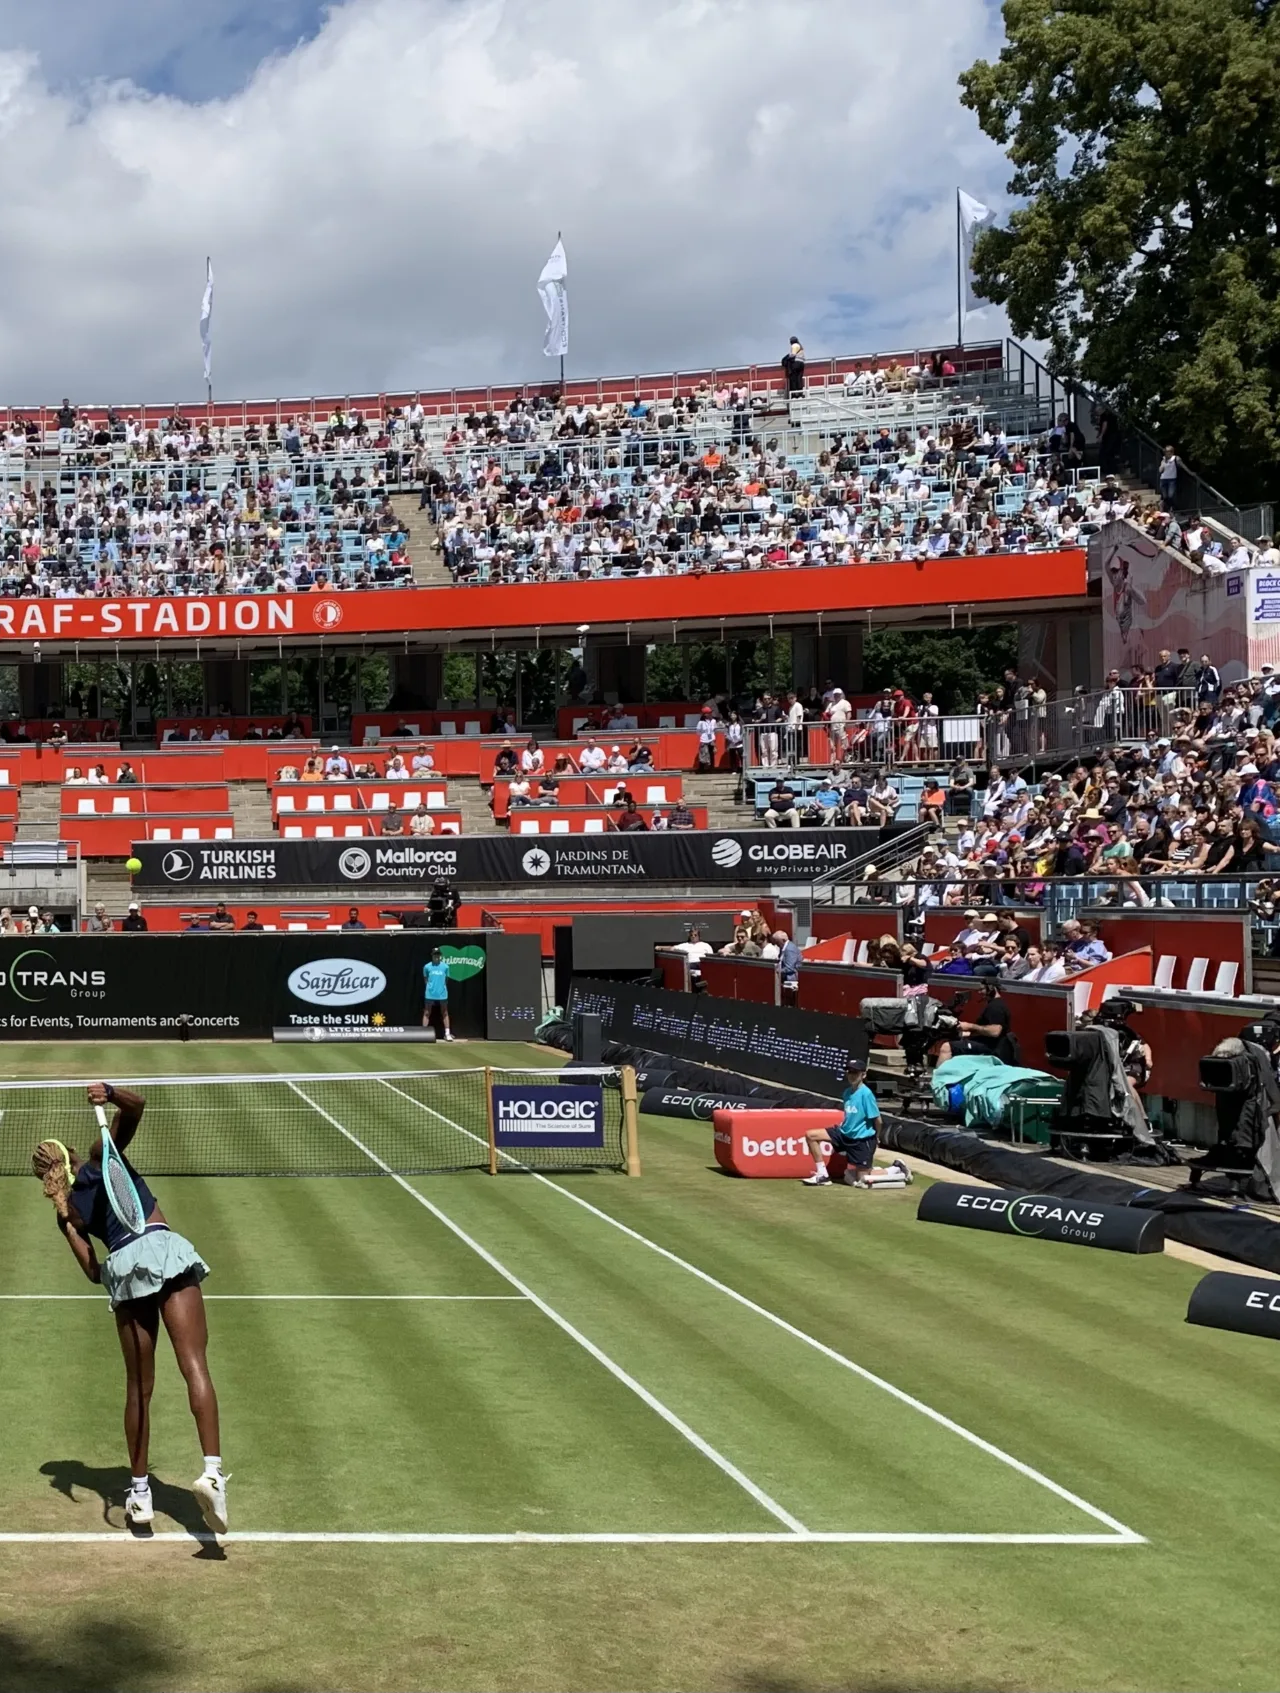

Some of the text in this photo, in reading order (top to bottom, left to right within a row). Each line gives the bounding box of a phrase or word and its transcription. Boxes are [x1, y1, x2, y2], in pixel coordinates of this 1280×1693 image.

[200, 850, 275, 864] TURKISH
[376, 847, 457, 864] Mallorca
[611, 850, 630, 861] DE
[748, 843, 847, 860] GLOBEAIR
[199, 864, 276, 880] AIRLINES
[376, 863, 457, 878] Country Club
[297, 967, 380, 997] SanLucar
[70, 988, 106, 999] Group
[9, 1015, 27, 1027] for
[29, 1016, 74, 1029] Events,
[76, 1015, 157, 1027] Tournaments
[289, 1014, 369, 1025] Taste the SUN
[498, 1100, 596, 1120] HOLOGIC
[1060, 1225, 1097, 1240] Group
